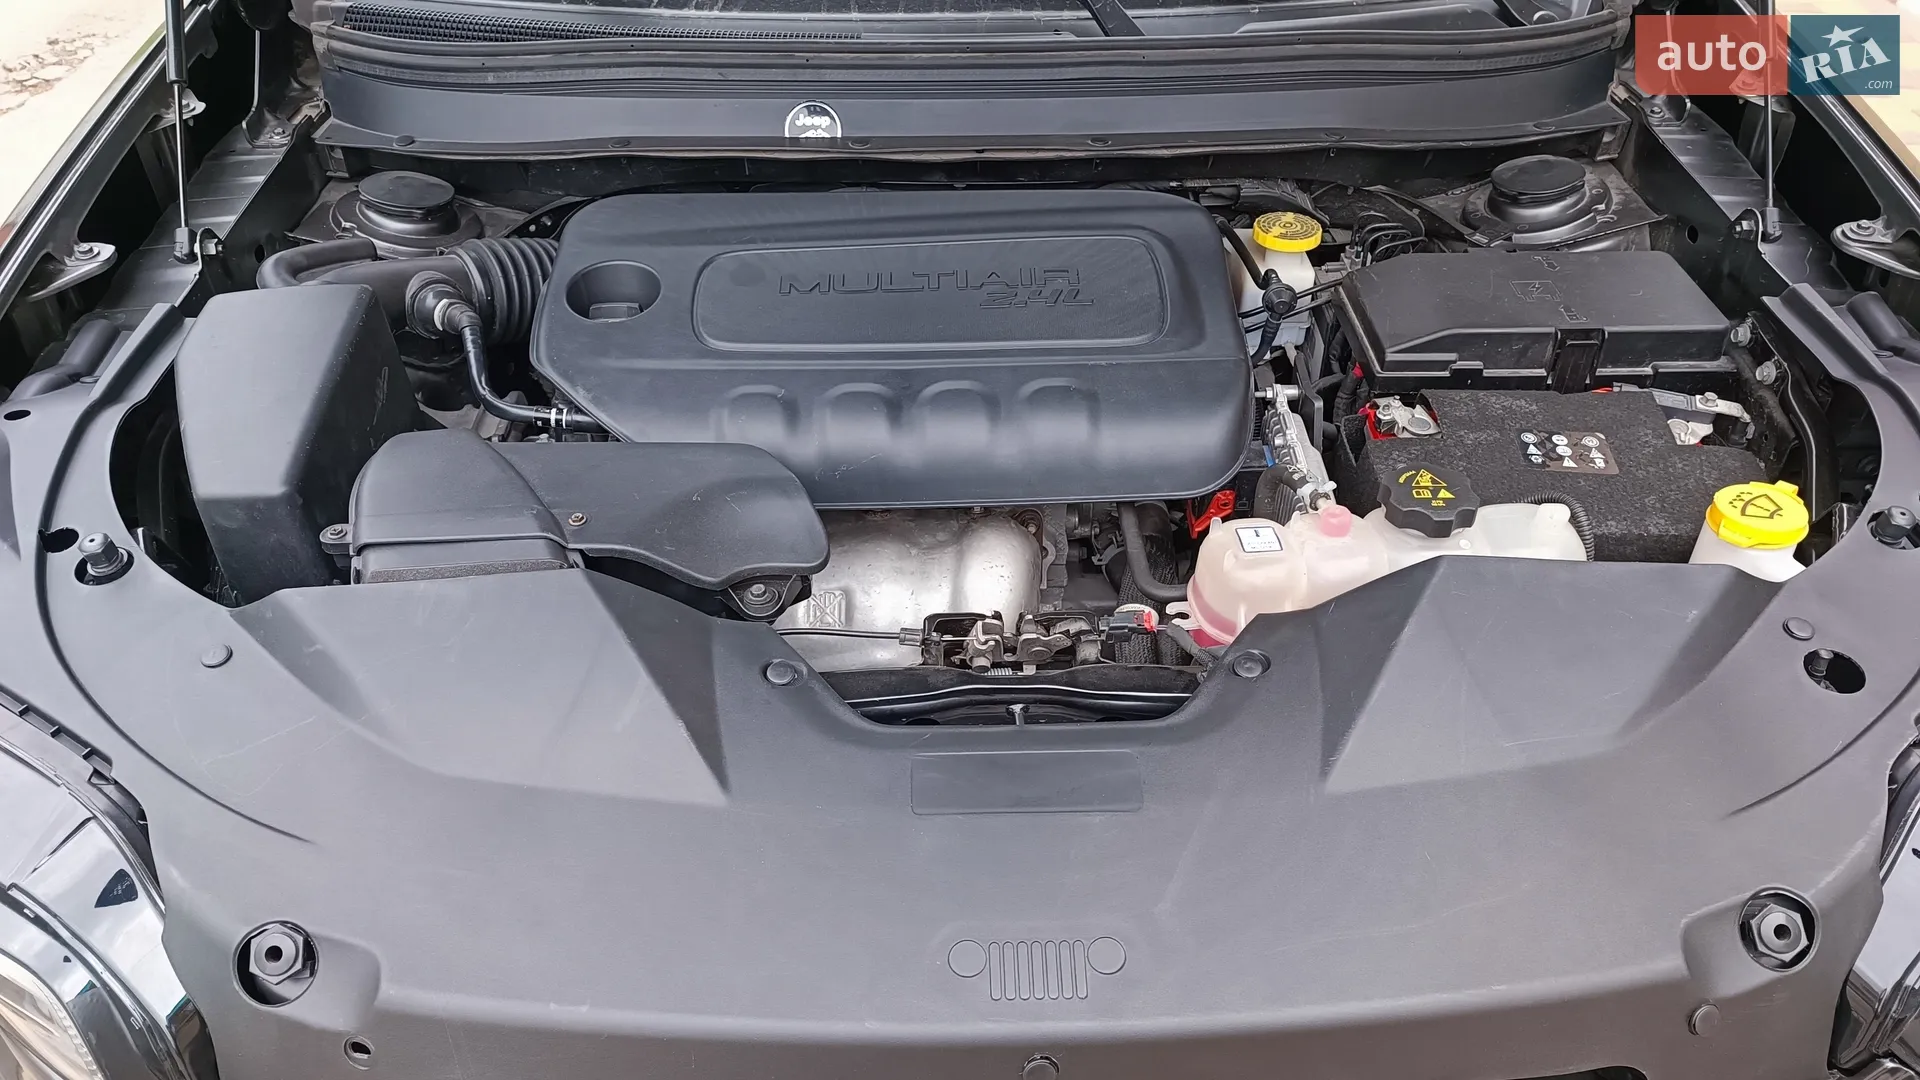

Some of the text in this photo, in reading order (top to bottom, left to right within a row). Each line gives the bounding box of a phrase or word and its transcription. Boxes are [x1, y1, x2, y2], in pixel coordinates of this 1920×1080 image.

[795, 113, 831, 129] Jeep
[778, 267, 1081, 297] MULTIAIR
[979, 288, 1095, 308] 2.4L
